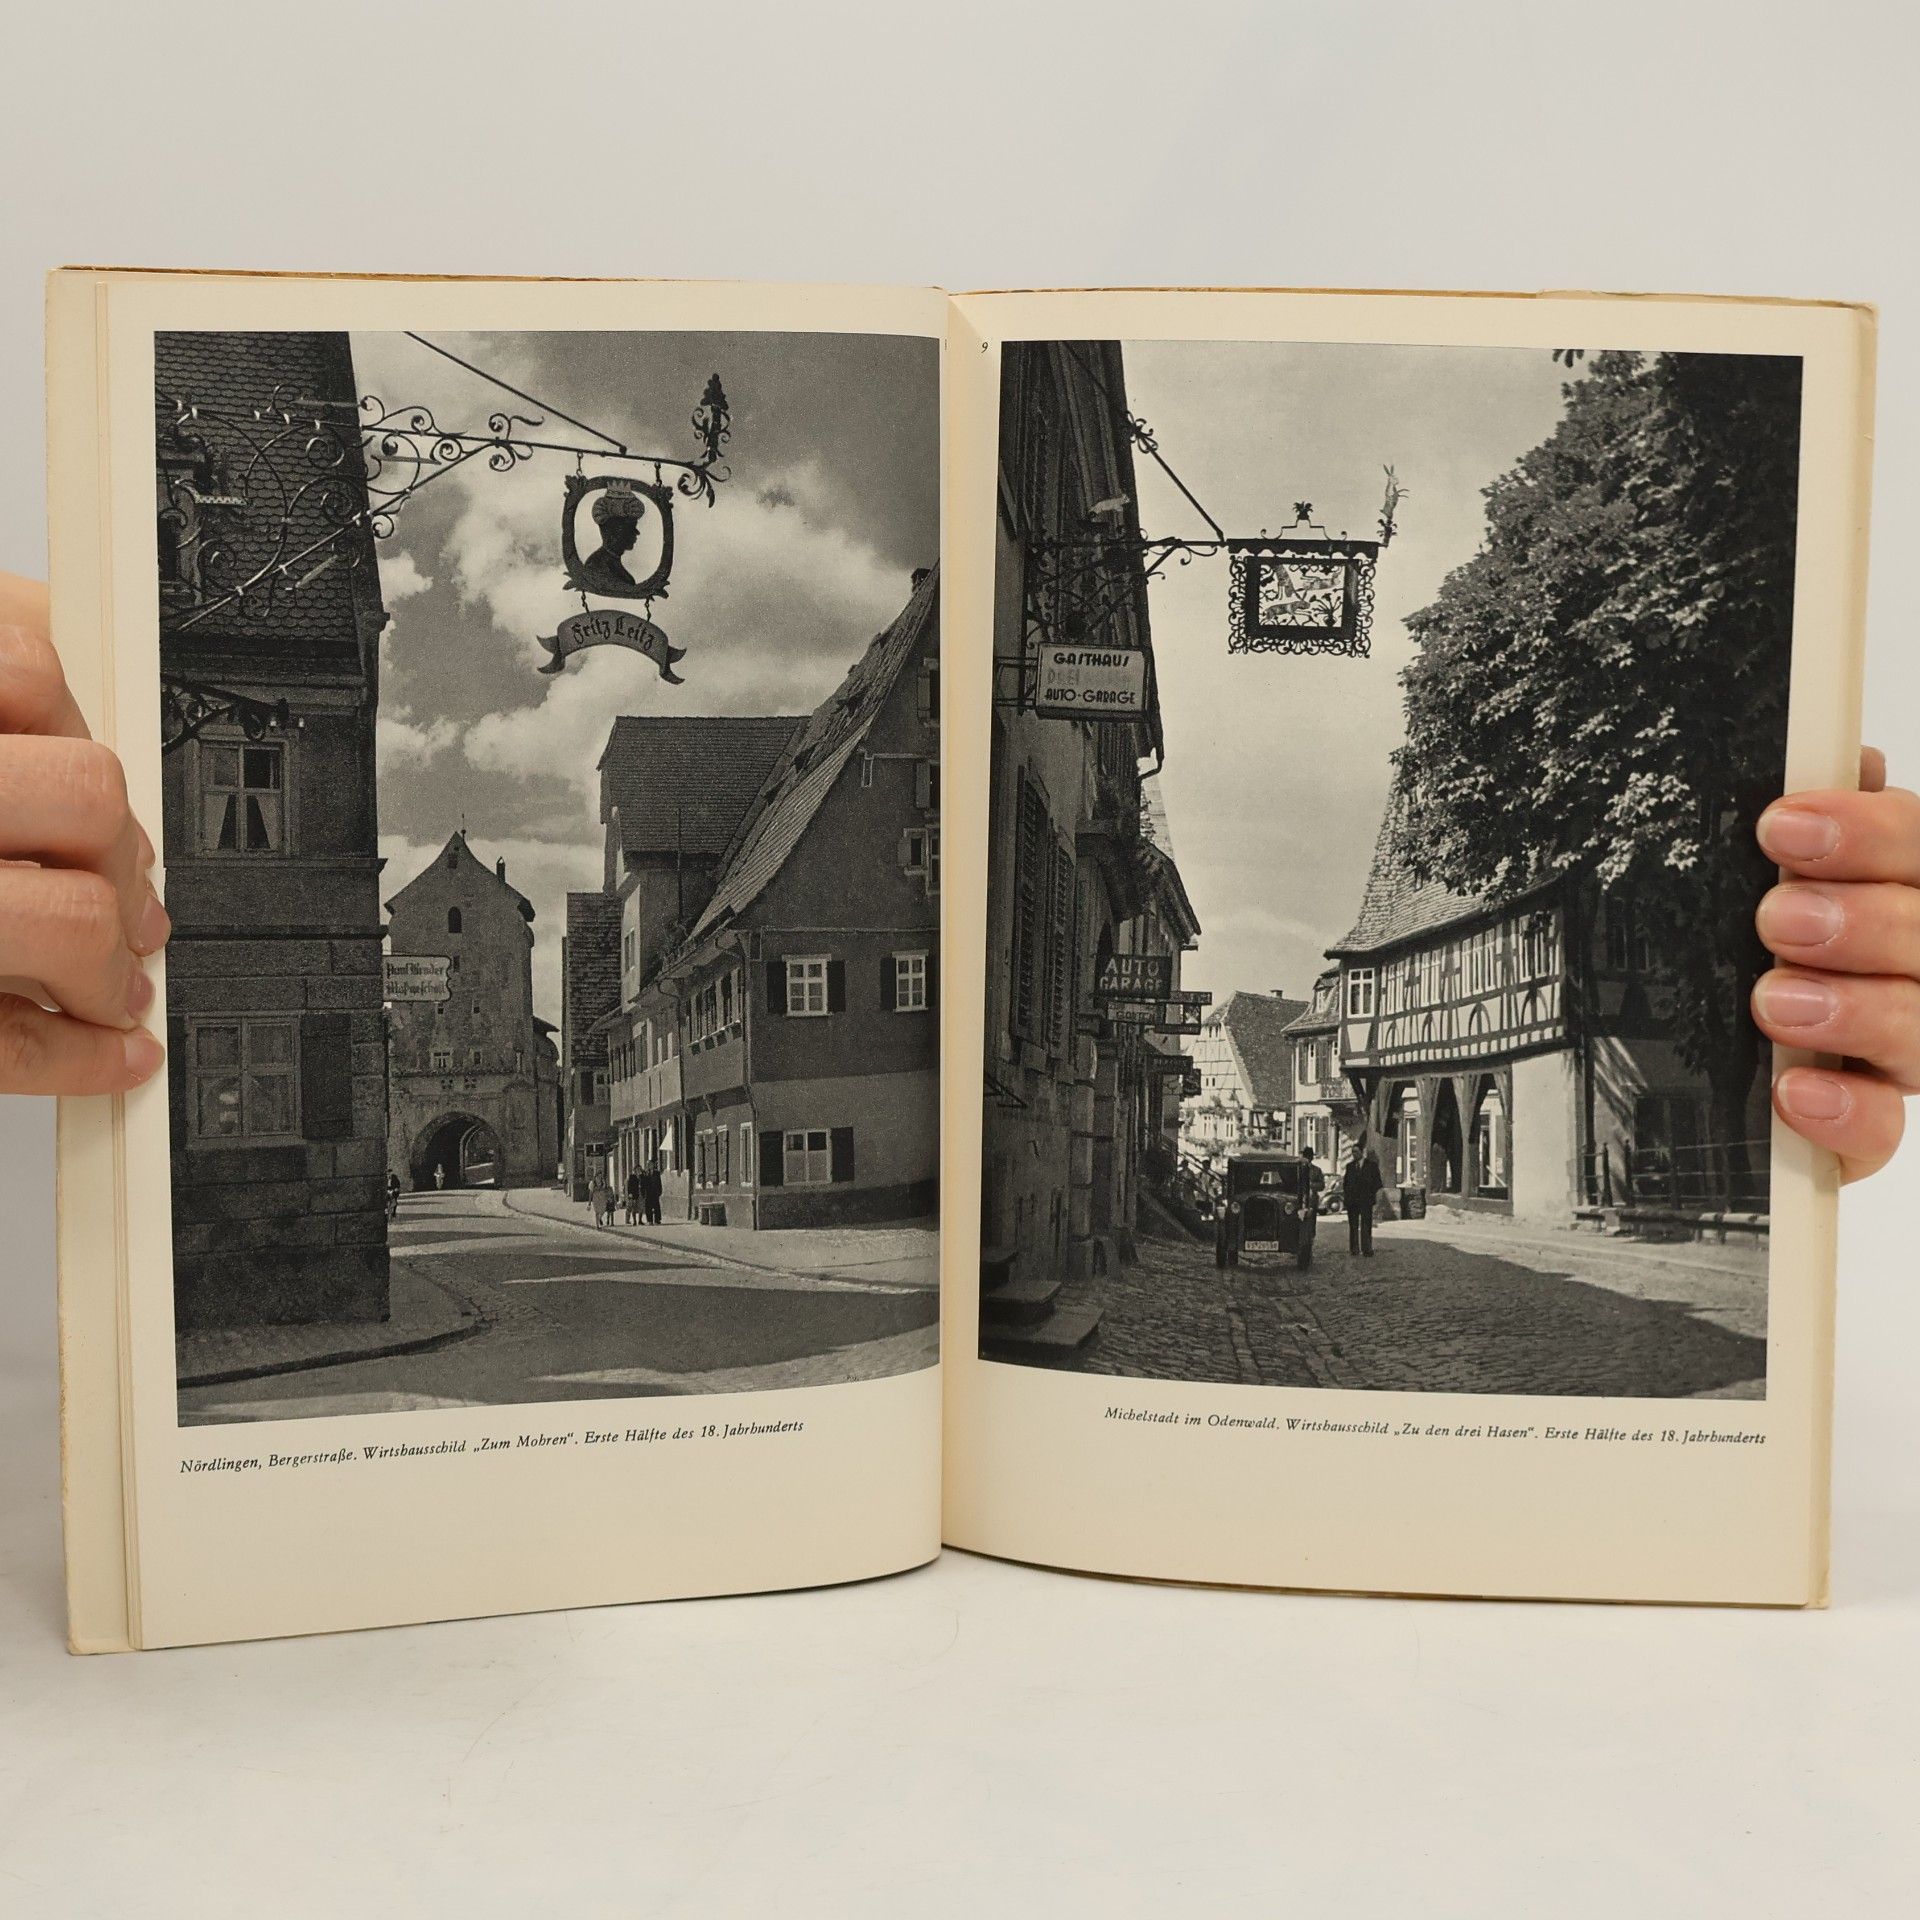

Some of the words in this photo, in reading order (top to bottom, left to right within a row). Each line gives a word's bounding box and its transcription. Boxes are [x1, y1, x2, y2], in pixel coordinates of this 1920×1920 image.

[980, 341, 990, 354] 9
[1053, 651, 1130, 668] GASTHAUS
[1104, 957, 1160, 977] AUTO
[1100, 976, 1163, 991] GARAGE
[1104, 1406, 1180, 1425] Michelstadt
[1184, 1413, 1202, 1426] im
[1207, 1414, 1281, 1430] Odenwald.
[1285, 1417, 1390, 1435] Wirtshausschild
[1424, 1423, 1451, 1438] den
[1454, 1423, 1483, 1438] drei
[1544, 1425, 1580, 1441] Erste
[1584, 1426, 1628, 1443] Hälfte
[1631, 1429, 1655, 1443] des
[179, 1457, 263, 1474] Nördlingen,
[268, 1447, 358, 1469] Bergerstraße.
[362, 1439, 467, 1460] Wirtshausschild
[584, 1429, 620, 1445] Erste
[624, 1427, 667, 1444] Hälfte
[671, 1426, 695, 1440] des
